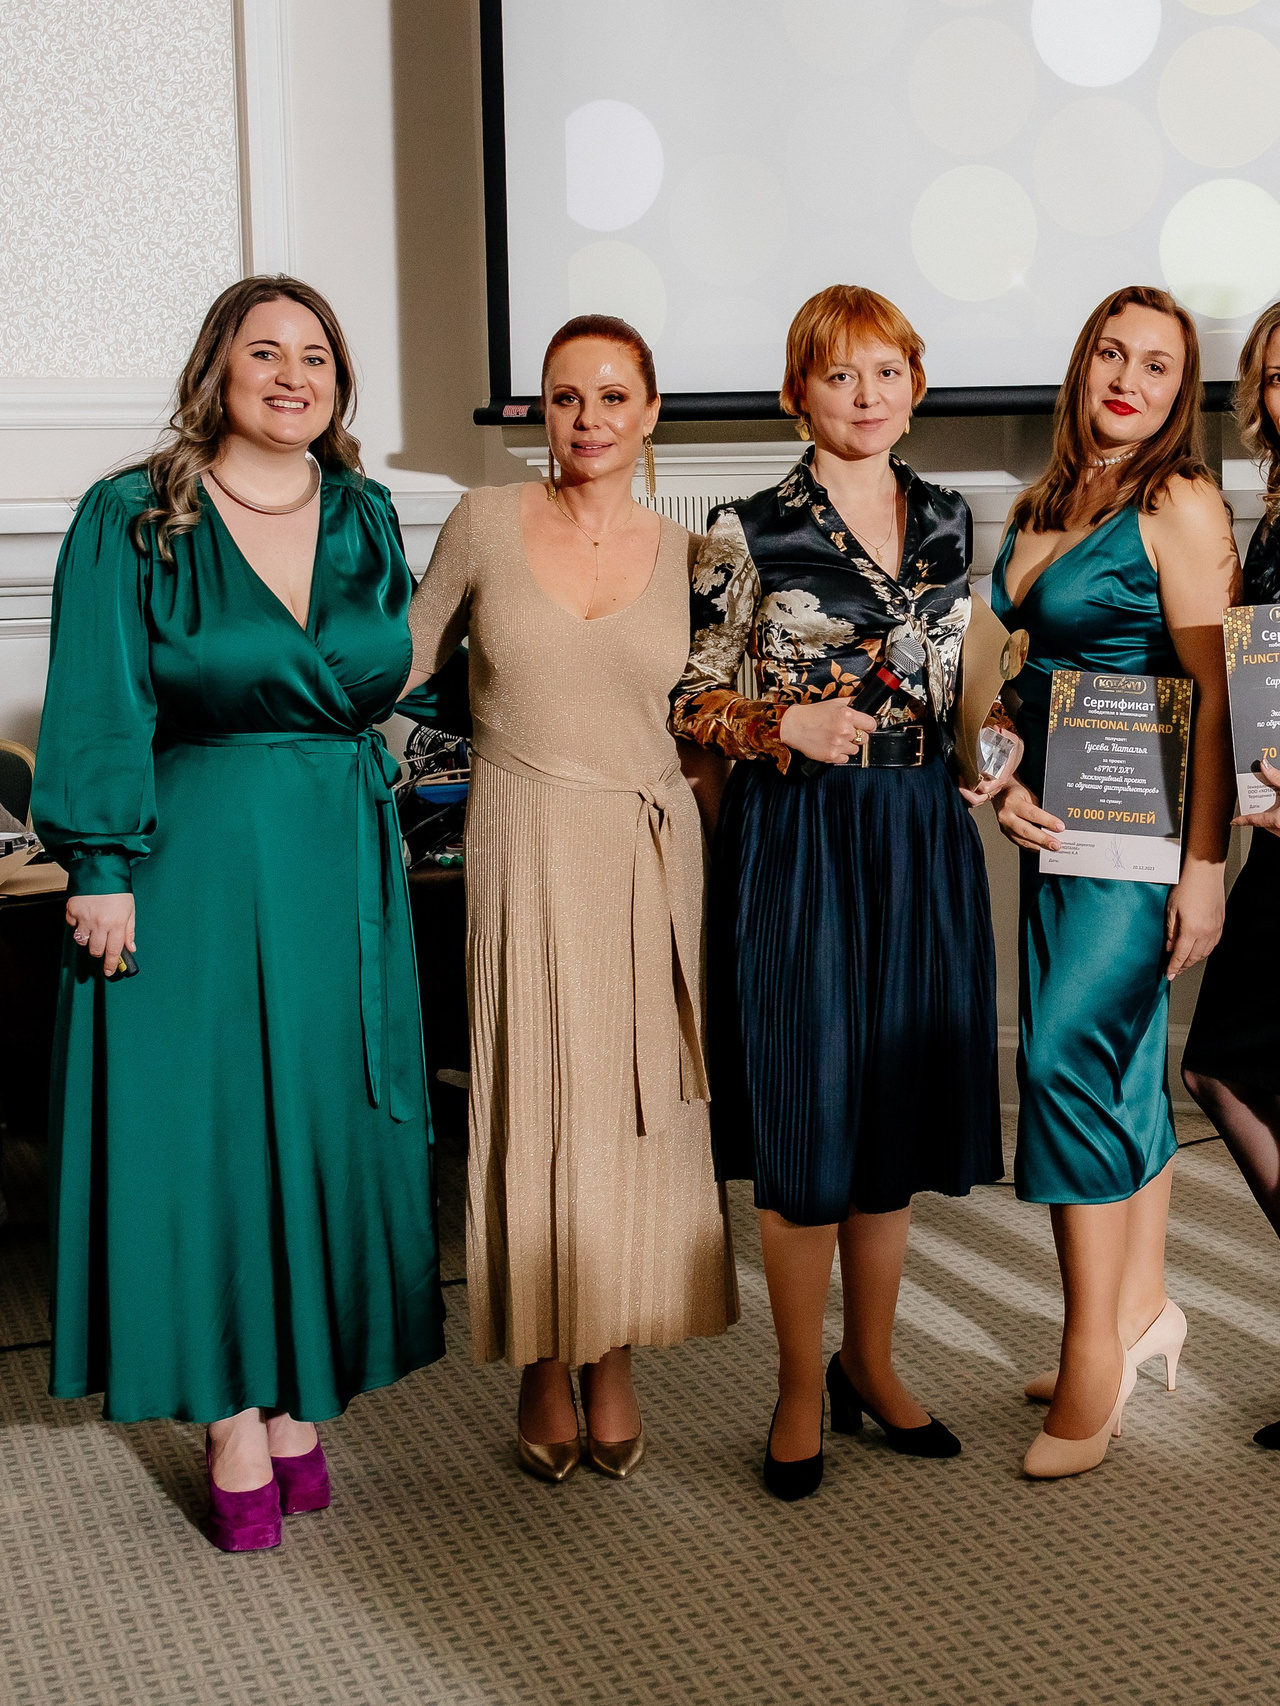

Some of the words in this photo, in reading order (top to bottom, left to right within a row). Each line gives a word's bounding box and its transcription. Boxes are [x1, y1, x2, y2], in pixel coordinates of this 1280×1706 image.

[1083, 696, 1155, 711] Сертификат
[1063, 717, 1129, 731] FUNCTIONAL
[1131, 721, 1172, 733] AWARD
[1084, 741, 1109, 753] Гусева
[1111, 742, 1148, 754] Наталья
[1261, 747, 1277, 760] 70
[1080, 772, 1123, 784] Эксклюзивный
[1123, 777, 1146, 785] проект
[1067, 807, 1081, 818] 70
[1083, 808, 1104, 820] 000
[1107, 810, 1155, 824] РУБЛЕЙ
